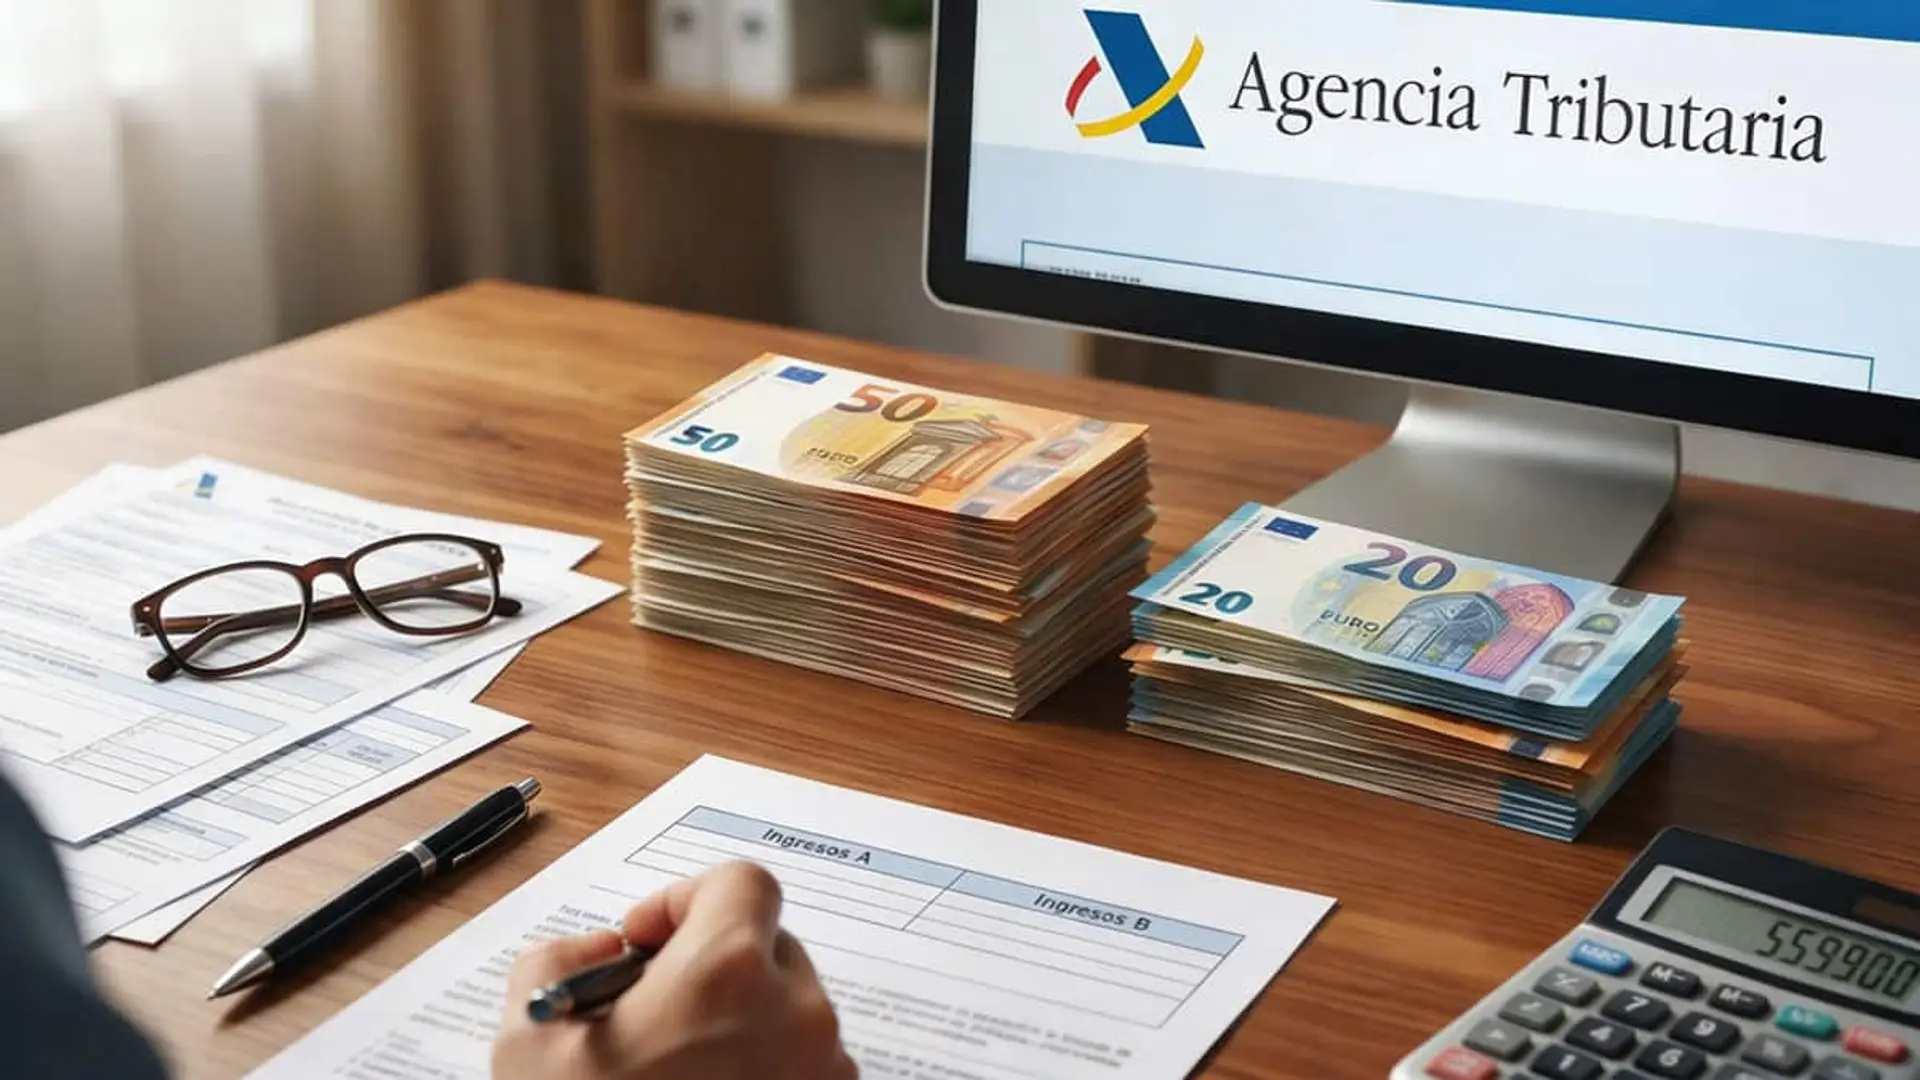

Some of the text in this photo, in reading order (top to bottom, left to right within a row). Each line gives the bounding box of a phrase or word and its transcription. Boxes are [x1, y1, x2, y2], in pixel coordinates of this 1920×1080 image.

[1228, 50, 1828, 164] Agencia Tributaria
[833, 383, 938, 422] 50
[669, 424, 740, 453] 50
[1342, 541, 1457, 591] 20
[1178, 582, 1255, 614] 20
[762, 826, 873, 866] Ingresos A
[1033, 892, 1153, 933] Ingresos B
[1755, 920, 1920, 998] 559900
[1625, 995, 1650, 1013] 7
[1558, 1053, 1577, 1071] 1
[1658, 1047, 1684, 1068] 6
